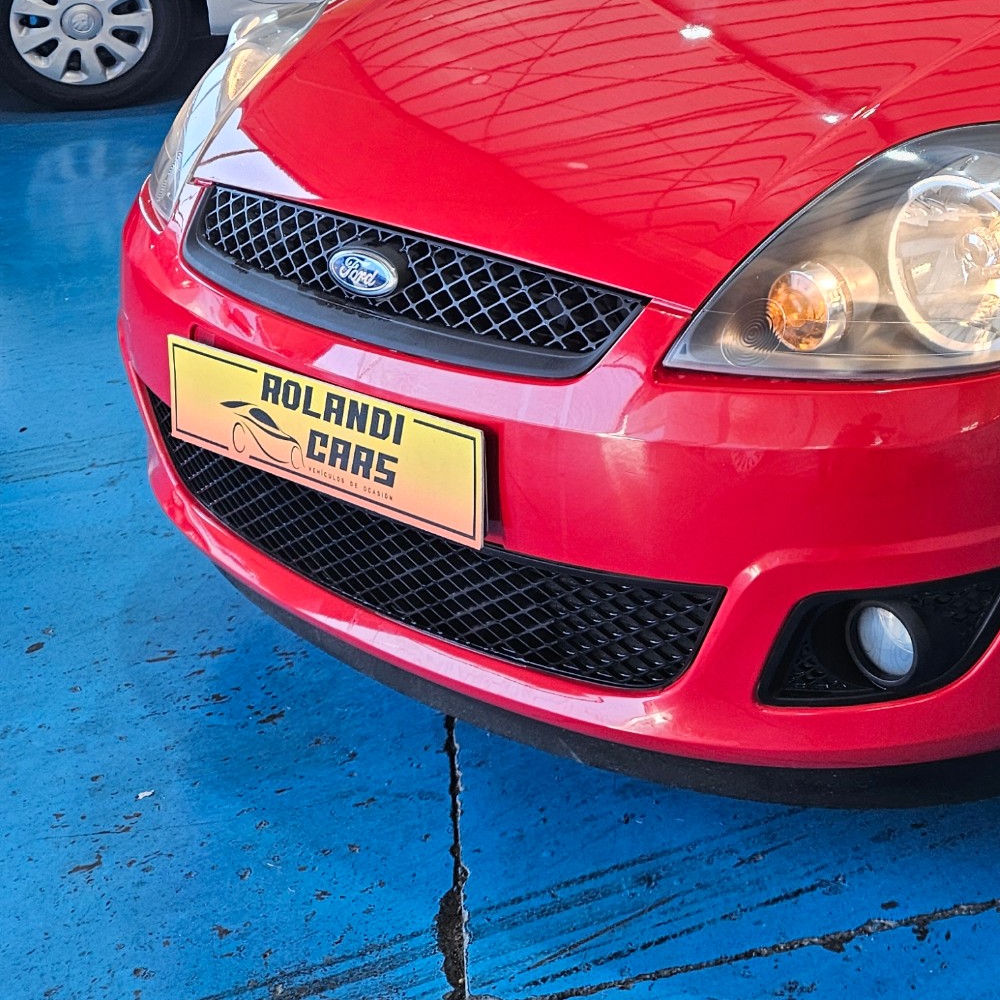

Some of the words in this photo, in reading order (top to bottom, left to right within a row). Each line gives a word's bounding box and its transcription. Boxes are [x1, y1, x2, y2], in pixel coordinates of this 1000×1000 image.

[339, 256, 379, 287] Ford
[261, 372, 405, 446] ROLANDI
[306, 429, 399, 488] CARS
[349, 480, 358, 489] DE
